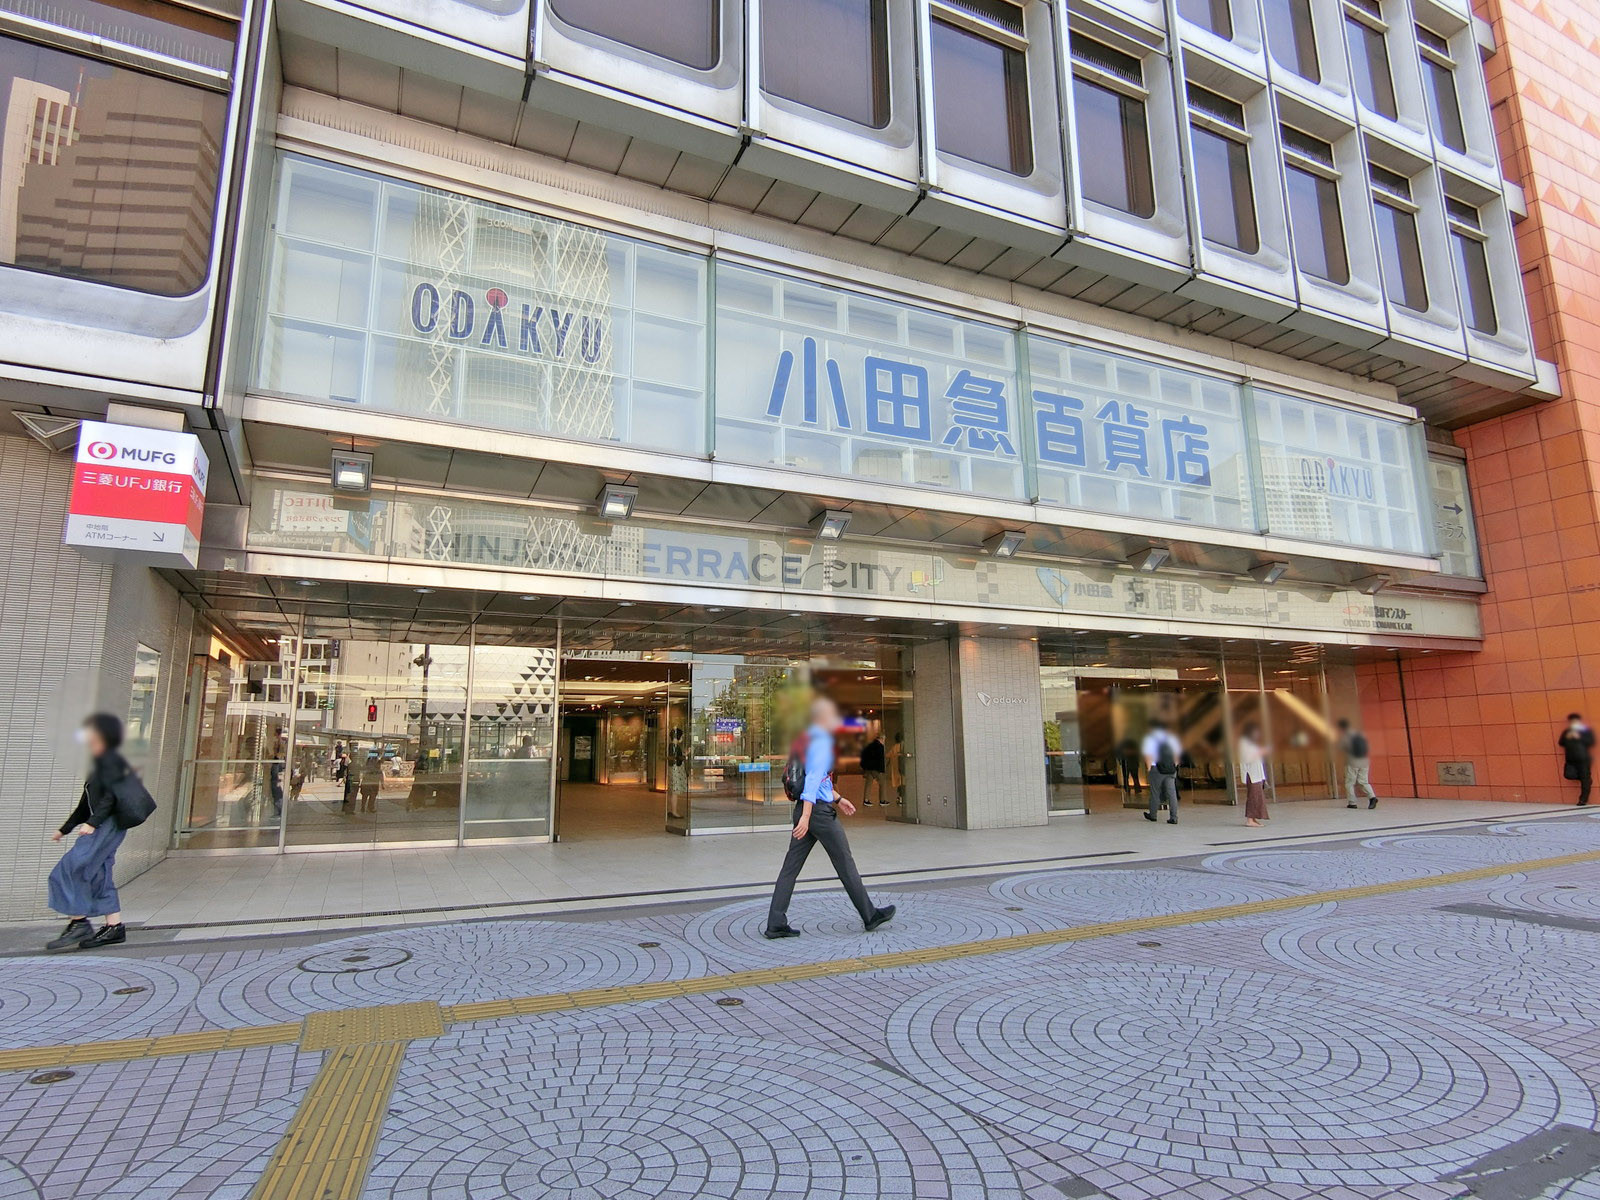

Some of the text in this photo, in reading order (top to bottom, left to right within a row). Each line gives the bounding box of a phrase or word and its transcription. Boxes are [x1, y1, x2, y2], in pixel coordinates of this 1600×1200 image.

[411, 282, 602, 364] ODAKYU
[766, 336, 1212, 486] 小田急百貨店
[121, 447, 176, 464] MUFG
[82, 471, 182, 494] 三菱UFJ銀行
[1301, 458, 1373, 500] ODAKYU
[85, 531, 138, 541] ATMコーナー
[1074, 582, 1114, 598] 小田急
[1128, 577, 1204, 612] 新宿駅
[992, 696, 1029, 704] odakyu
